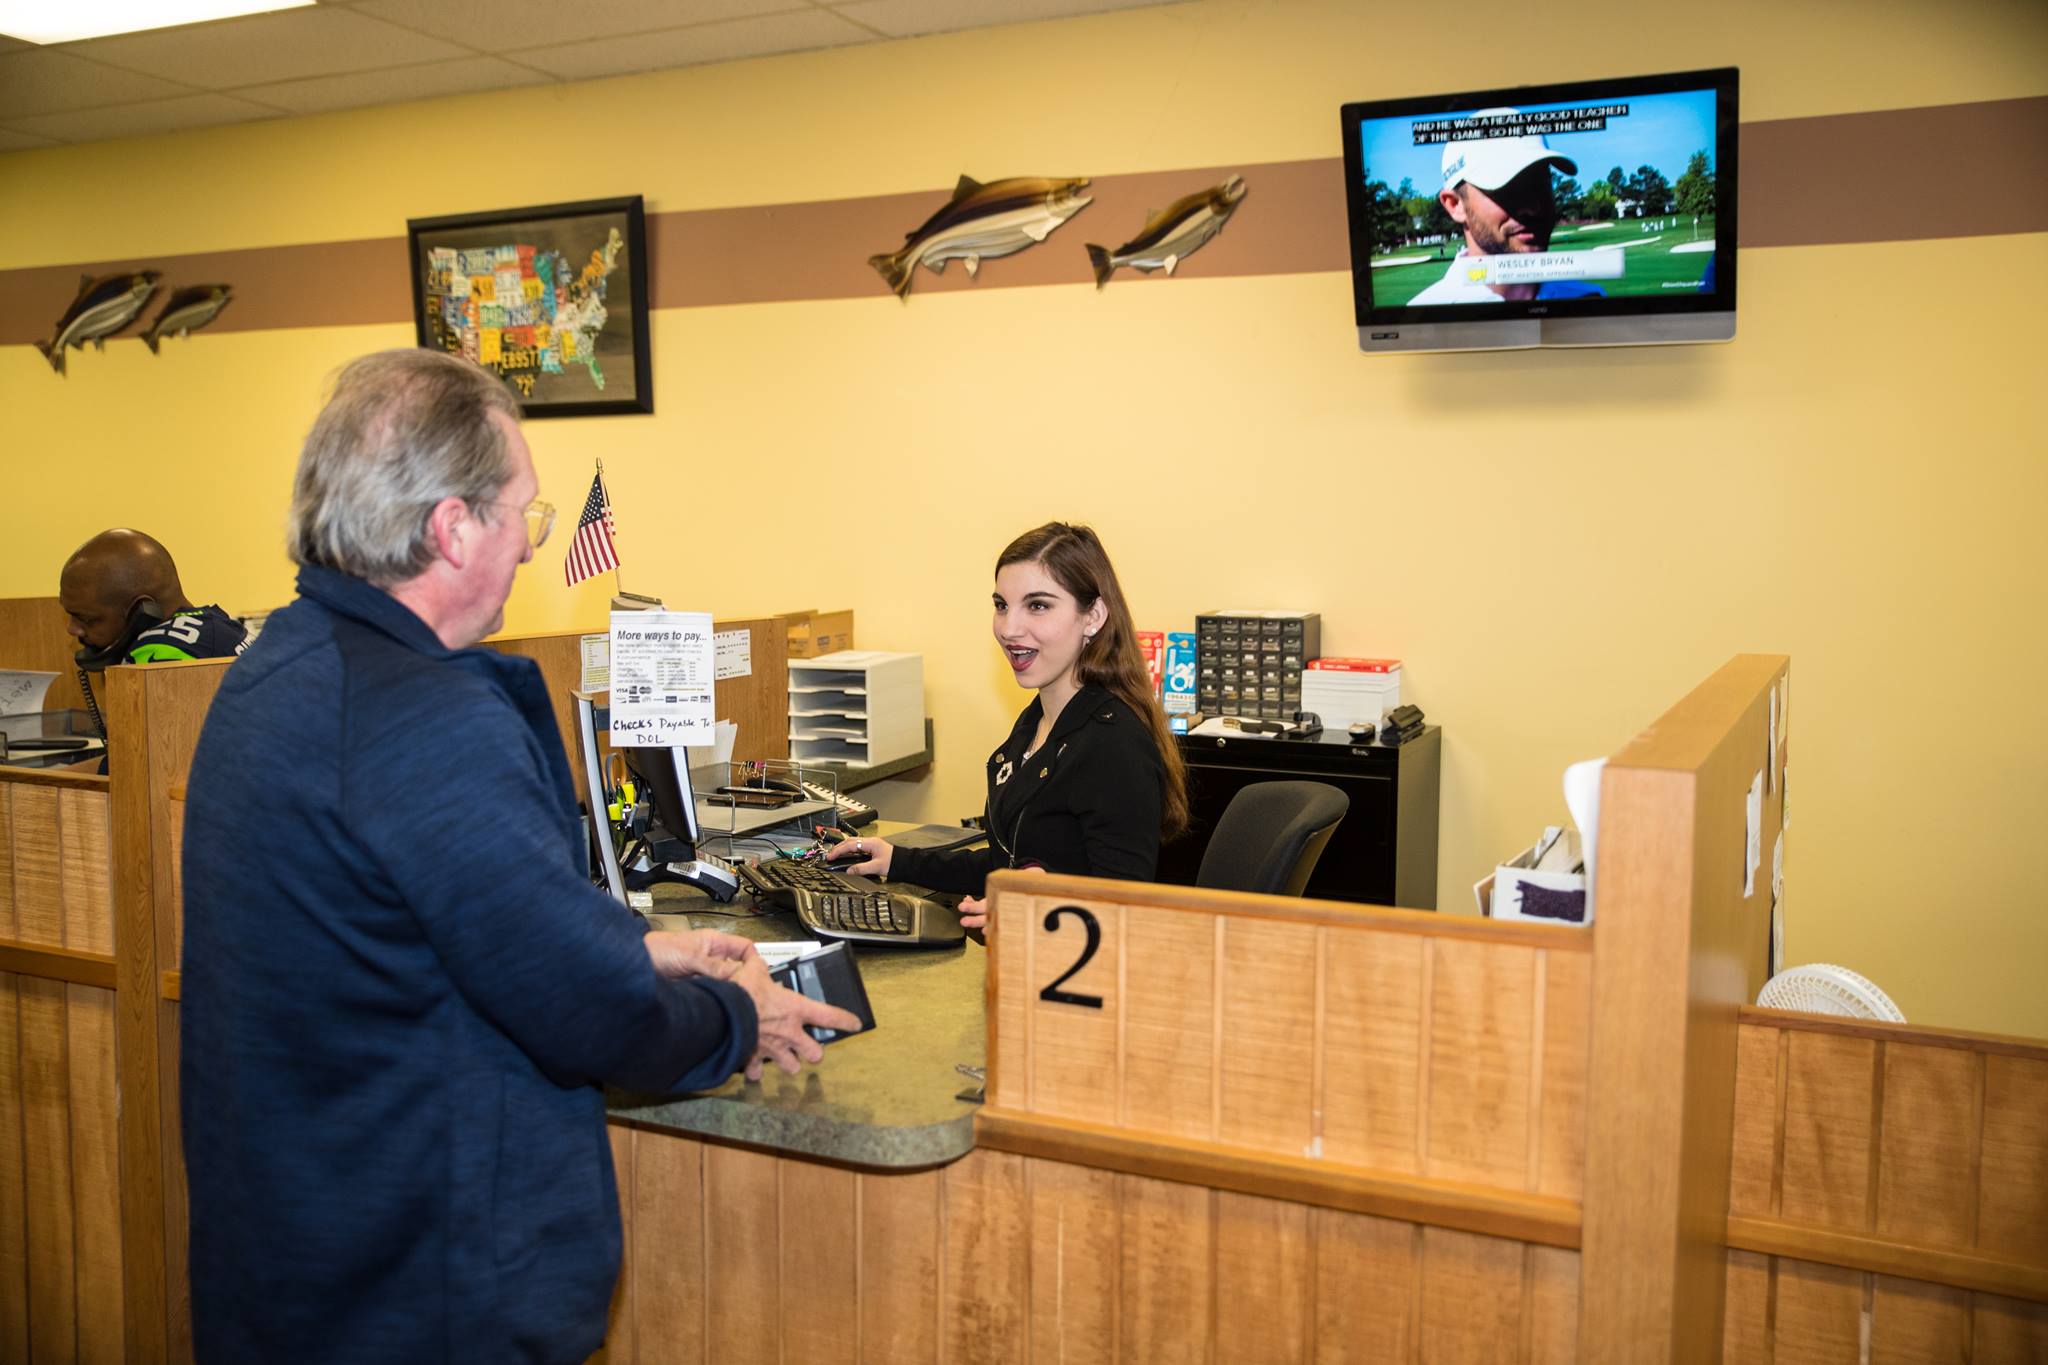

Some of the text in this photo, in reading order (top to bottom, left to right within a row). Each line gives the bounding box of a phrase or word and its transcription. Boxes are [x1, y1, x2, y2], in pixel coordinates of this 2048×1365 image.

[1413, 105, 1626, 131] AND HE WAS A REALLY GOOD TEACHER
[1414, 133, 1428, 144] OF
[1431, 132, 1451, 143] THE
[1489, 127, 1507, 138] SO
[1508, 125, 1523, 136] HE
[1526, 123, 1552, 134] WAS
[1554, 121, 1575, 132] THE
[1577, 119, 1603, 130] ONE
[1498, 256, 1575, 270] WESLEY BRYAN
[617, 630, 707, 643] More ways to pay...
[636, 734, 665, 744] DOL
[1040, 905, 1103, 1009] 2
